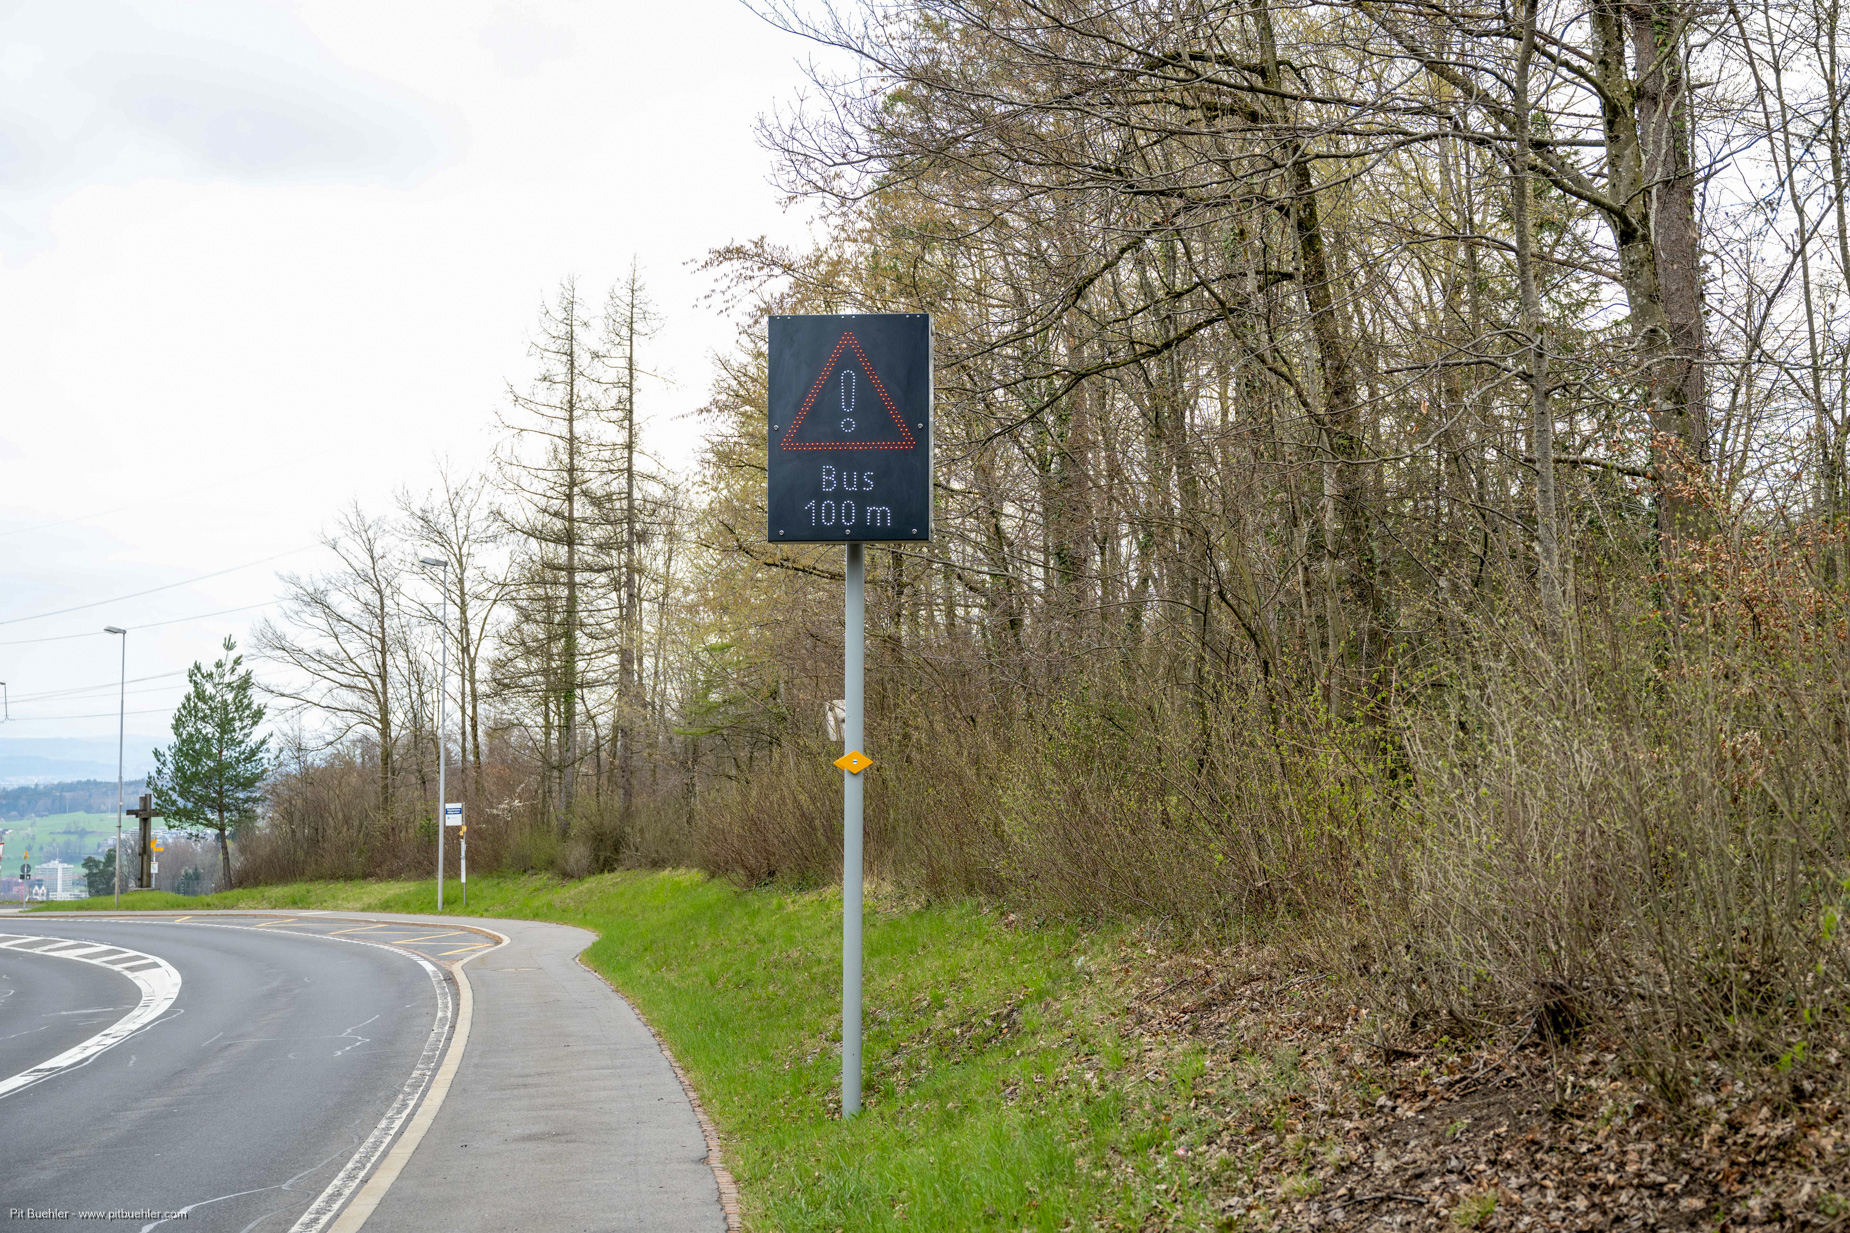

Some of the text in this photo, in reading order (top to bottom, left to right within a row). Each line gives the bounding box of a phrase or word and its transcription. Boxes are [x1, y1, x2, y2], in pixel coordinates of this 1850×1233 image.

[822, 465, 874, 492] Bus
[804, 499, 891, 526] 100 m
